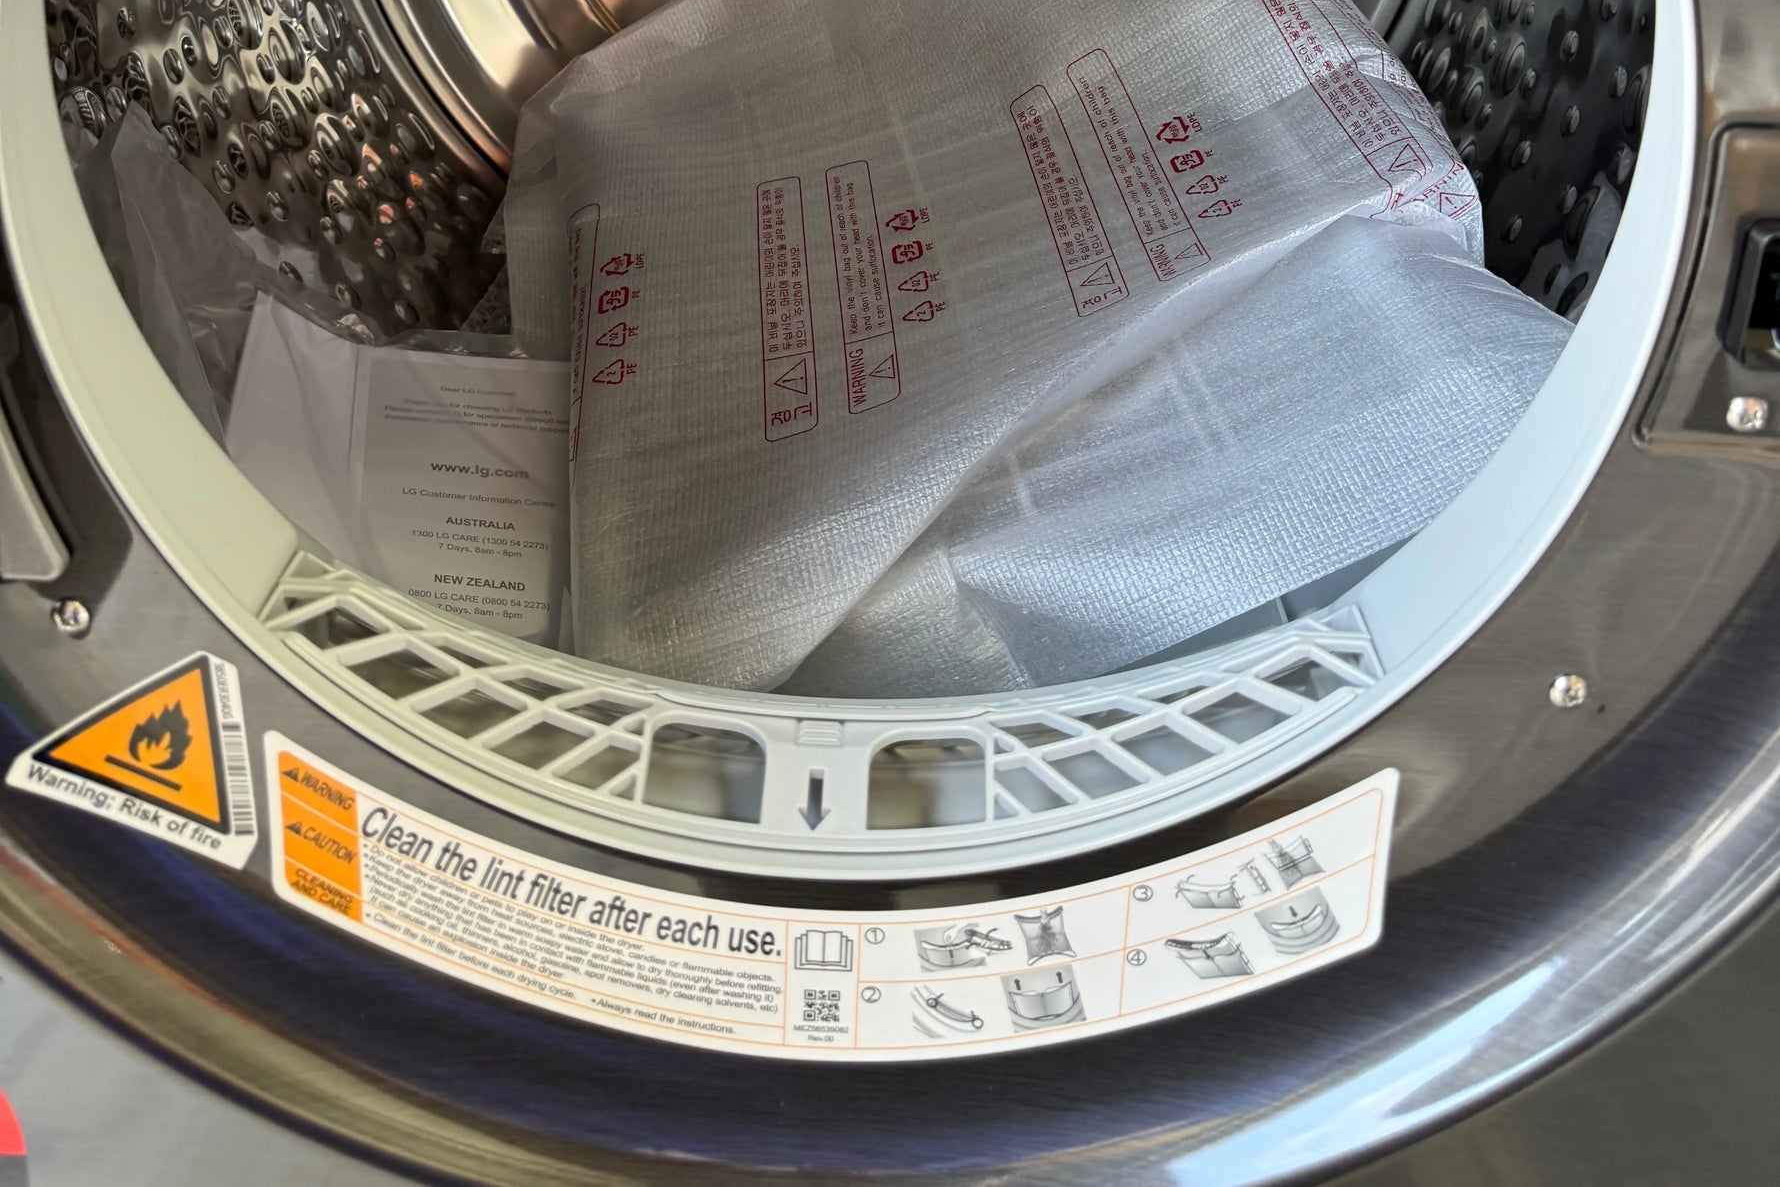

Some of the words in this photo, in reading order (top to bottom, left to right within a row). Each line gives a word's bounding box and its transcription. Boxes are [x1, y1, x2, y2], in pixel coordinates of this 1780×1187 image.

[1078, 76, 1102, 116] children
[1097, 85, 1110, 106] bag
[1097, 119, 1107, 128] of
[1107, 107, 1120, 125] this
[1186, 112, 1203, 133] LDPE
[1104, 131, 1118, 152] reach
[1116, 128, 1128, 145] with
[1124, 146, 1136, 164] head
[1204, 149, 1214, 158] PE
[1216, 174, 1229, 184] PE
[833, 175, 843, 202] children
[846, 182, 854, 196] bag
[847, 197, 856, 210] this
[1230, 198, 1243, 208] PE
[849, 212, 858, 226] with
[919, 207, 930, 224] LDPE
[1136, 206, 1146, 218] the
[838, 233, 848, 241] of
[851, 228, 860, 245] head
[840, 242, 849, 255] out
[925, 242, 934, 251] PE
[635, 253, 645, 269] LDPE
[855, 247, 865, 264] your
[842, 257, 852, 272] bag
[843, 275, 854, 293] vinyl
[857, 267, 867, 288] cover
[929, 271, 939, 282] PE
[631, 290, 640, 299] PE
[872, 277, 882, 301] cause
[847, 296, 856, 309] the
[859, 291, 870, 312] don't
[934, 301, 946, 312] PE
[876, 304, 885, 319] can
[627, 325, 639, 337] PE
[849, 313, 858, 335] Keep
[862, 315, 873, 331] and
[626, 363, 637, 375] PE
[848, 348, 866, 406] WARNING
[431, 463, 530, 479] www.lg.com
[402, 487, 417, 495] LG
[419, 488, 466, 500] Customer
[469, 494, 522, 505] Information
[446, 516, 515, 531] AUSTRALIA
[412, 529, 434, 538] 1300
[435, 531, 450, 540] LG
[451, 533, 479, 543] CARE
[482, 537, 508, 546] (1300
[509, 539, 521, 547] 54
[523, 540, 549, 551] 2273)
[474, 546, 495, 555] 8am
[502, 549, 522, 558] 8pm
[434, 573, 464, 585] NEW
[466, 577, 525, 591] ZEALAND
[407, 588, 432, 598] 0800
[433, 591, 448, 600] LG
[450, 593, 479, 604] CARE
[481, 596, 508, 607] (0800
[510, 599, 522, 607] 54
[523, 600, 552, 613] 2273)
[473, 607, 494, 616] 8am
[502, 609, 523, 619] 8pm
[300, 772, 354, 811] WARNING
[119, 797, 164, 825] Risk
[166, 820, 190, 835] of
[190, 826, 221, 849] fire
[302, 826, 356, 864] CAUTION
[294, 868, 354, 903] CLEANING
[361, 807, 433, 863] Clean
[435, 842, 477, 881] the
[479, 857, 524, 899] lint
[526, 873, 587, 917] filter
[589, 896, 652, 934] after
[656, 915, 719, 948] each
[728, 928, 781, 956] use.
[291, 879, 317, 897] AND
[318, 892, 351, 915] CARE
[599, 933, 615, 944] the
[373, 913, 401, 931] Clean
[402, 927, 418, 939] the
[419, 934, 435, 947] lint
[458, 951, 489, 969] before
[491, 966, 515, 978] each
[516, 974, 547, 992] drying
[669, 980, 697, 991] (even
[698, 984, 720, 995] after
[722, 990, 762, 1003] washing
[715, 978, 745, 989] before
[655, 987, 671, 997] dry
[673, 991, 713, 1006] cleaning
[596, 998, 632, 1014] Always
[634, 1009, 657, 1020] read
[659, 1013, 675, 1024] the
[677, 1018, 734, 1034] instructions.
